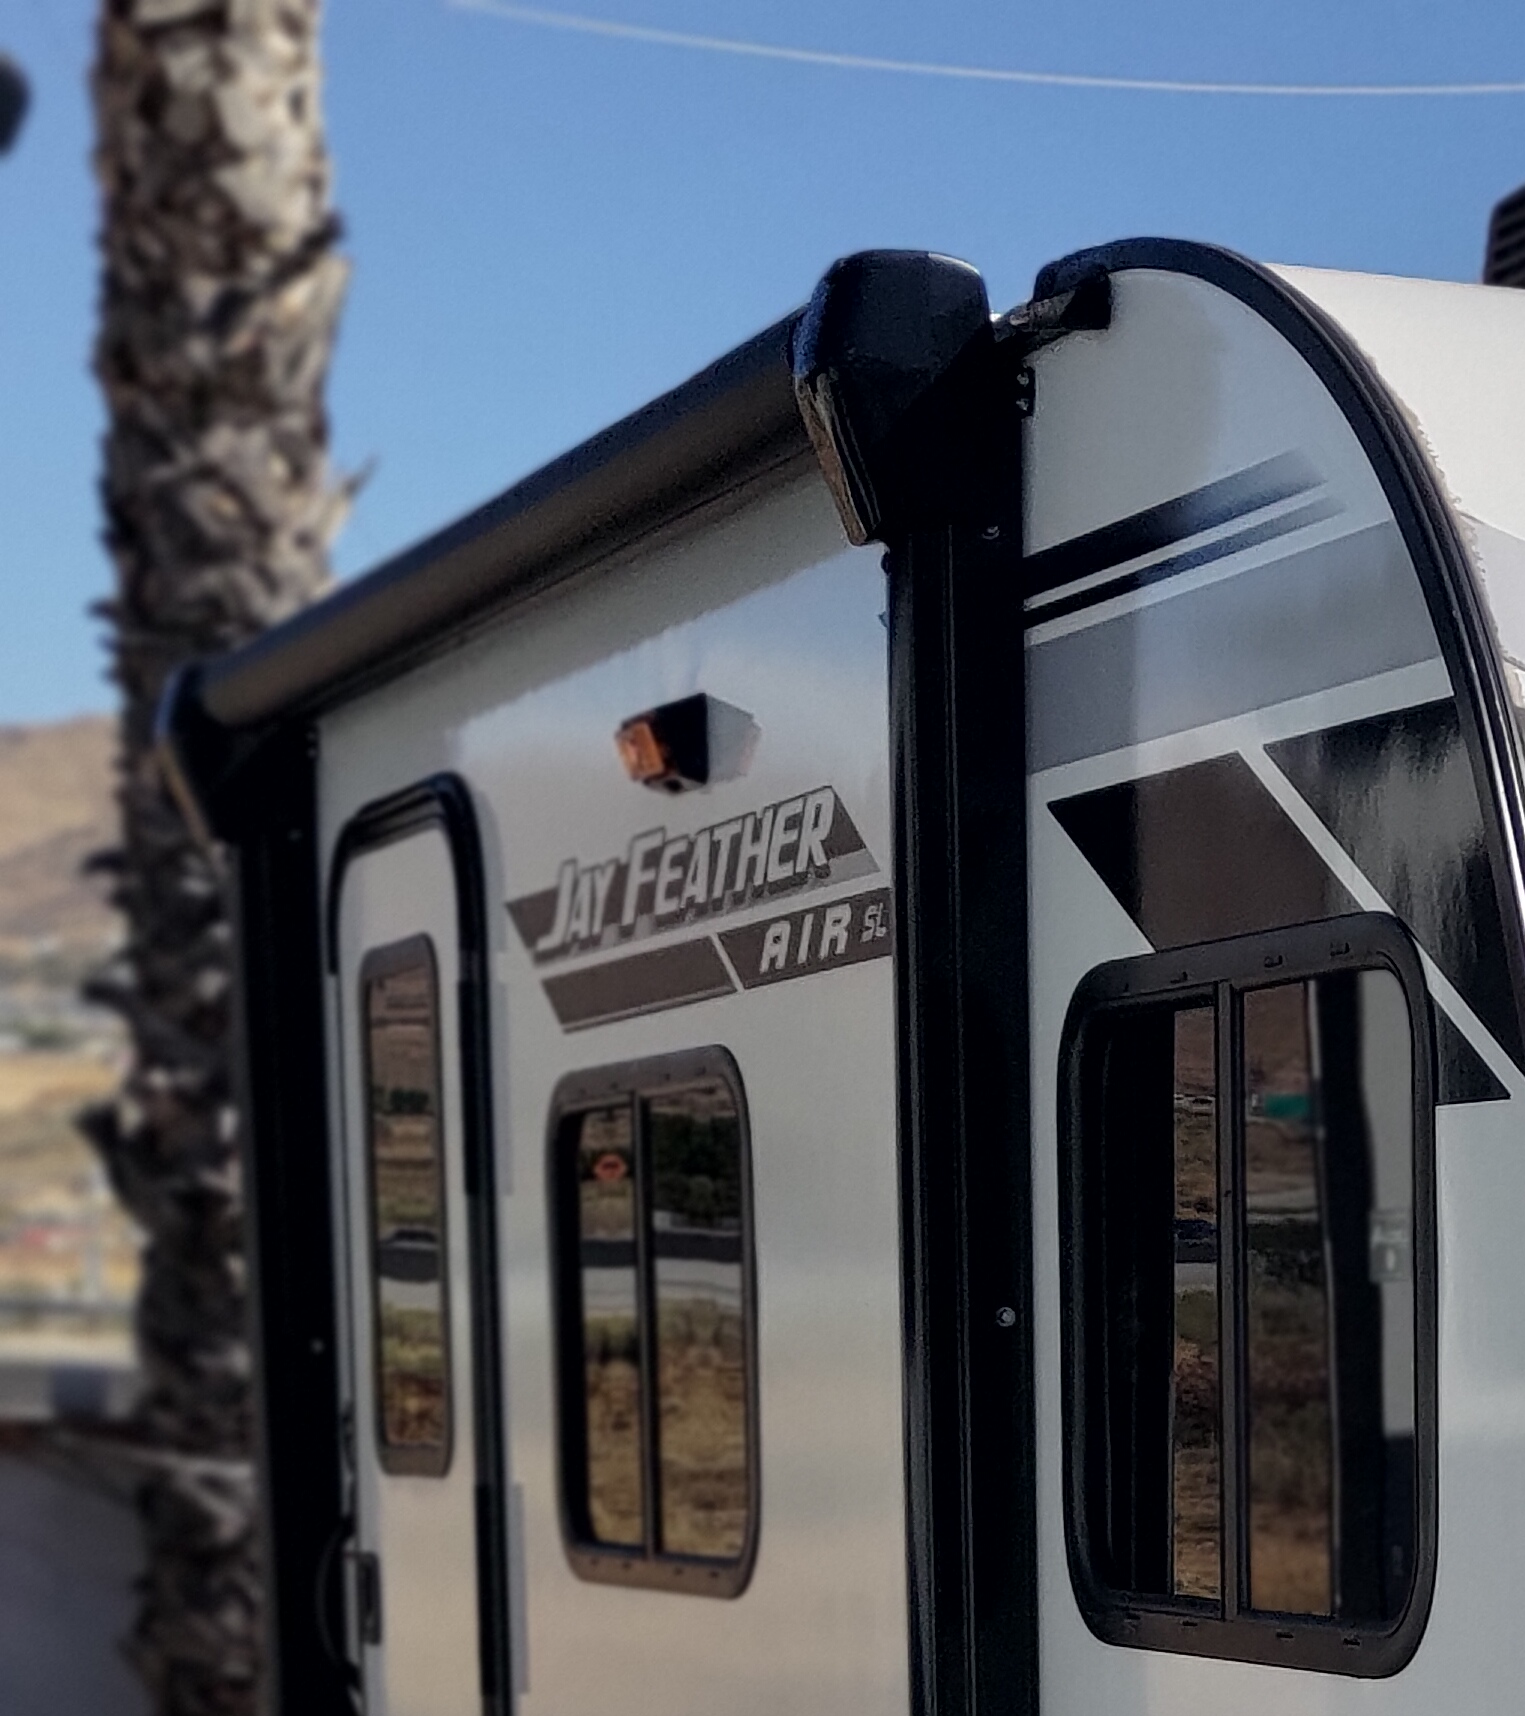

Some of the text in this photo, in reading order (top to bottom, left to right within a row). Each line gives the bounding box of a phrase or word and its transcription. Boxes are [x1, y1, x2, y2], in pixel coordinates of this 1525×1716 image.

[535, 785, 836, 953] JAY FEATHER
[759, 902, 852, 974] AIR
